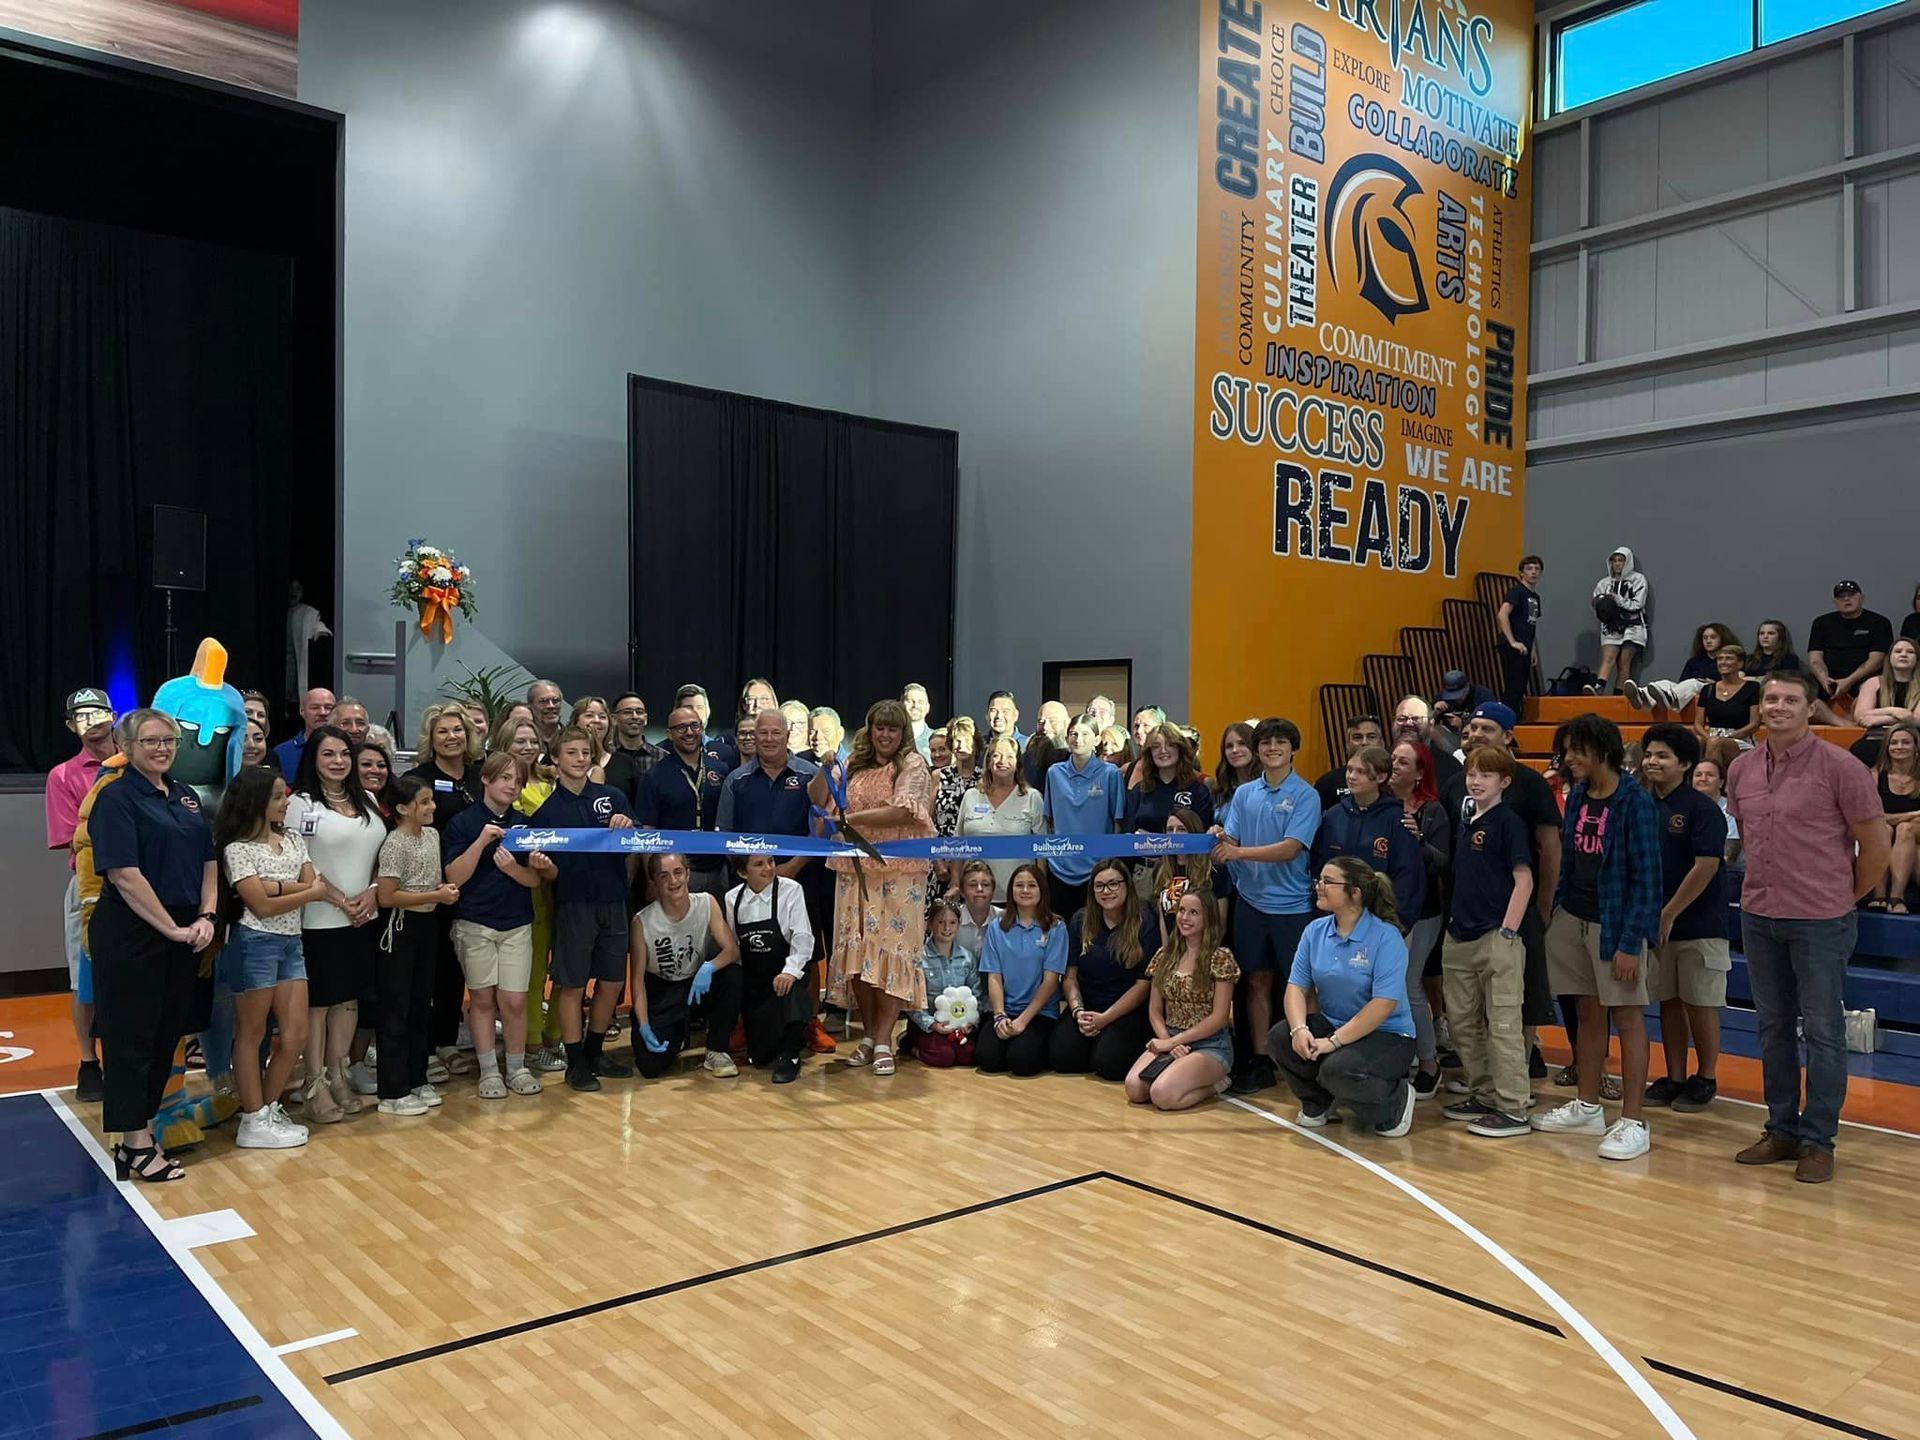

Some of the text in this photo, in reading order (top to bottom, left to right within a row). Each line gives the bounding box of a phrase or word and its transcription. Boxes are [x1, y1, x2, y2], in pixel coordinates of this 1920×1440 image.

[1215, 0, 1262, 199] CREATE
[1269, 24, 1285, 115] CHOICE
[1289, 22, 1327, 164] BUILD
[1333, 48, 1391, 94] EXPLORE
[1401, 67, 1519, 160] MOTIVATE
[1348, 94, 1518, 198] COLLABORATE
[1263, 129, 1285, 335] CULINARY
[1287, 173, 1319, 328] THEATER
[1436, 190, 1467, 304] ARTS
[1490, 205, 1504, 310] ATHLETICS
[1238, 211, 1257, 365] COMMUNITY
[1465, 195, 1485, 442] TECHNOLOGY
[1265, 342, 1436, 418] INSPIRATION
[1319, 322, 1456, 387] COMMITMENT
[1484, 319, 1516, 451] PRIDE
[1210, 371, 1385, 470] SUCCESS
[1401, 418, 1453, 447] IMAGINE
[1405, 443, 1513, 497] WE ARE
[1273, 459, 1470, 579] READY
[620, 836, 674, 847] Bullhead Area
[726, 839, 778, 850] Bullhead Area
[930, 844, 982, 855] Bullhead Area
[1033, 843, 1084, 852] Bullhead Area
[1167, 842, 1184, 852] Area
